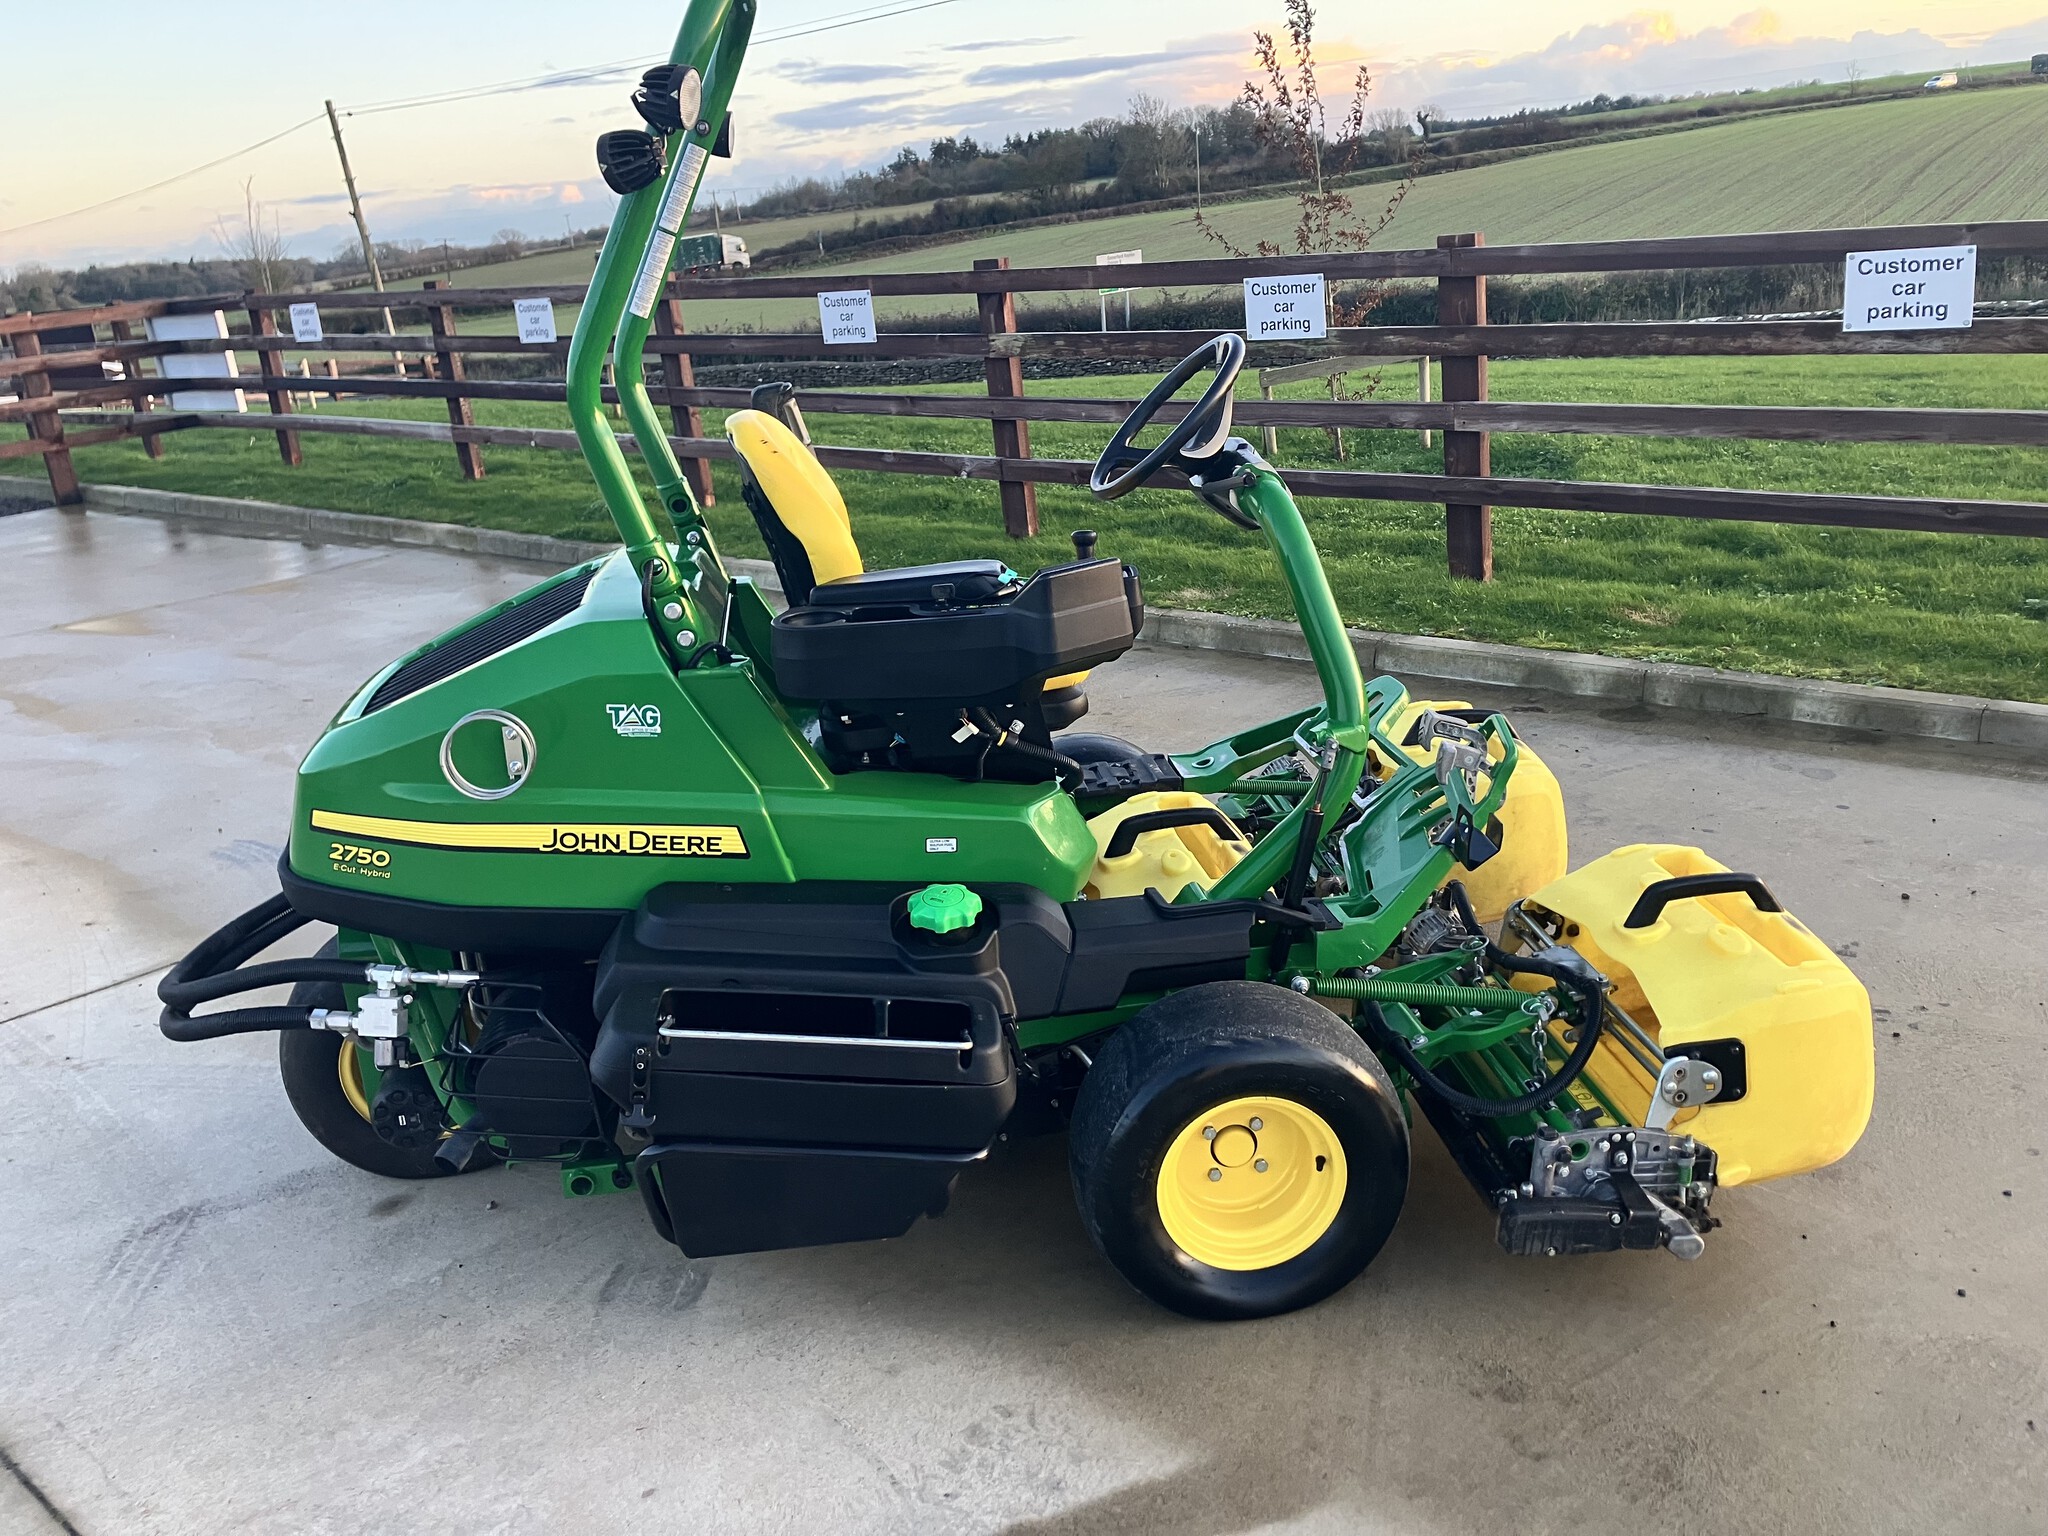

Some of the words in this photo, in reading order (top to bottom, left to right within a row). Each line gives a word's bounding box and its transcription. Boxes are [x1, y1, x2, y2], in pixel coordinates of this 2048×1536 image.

[1858, 257, 1965, 275] Customer
[1251, 282, 1317, 296] Customer
[1892, 282, 1926, 296] car
[517, 303, 549, 314] Customer
[823, 296, 867, 308] Customer
[1274, 302, 1295, 313] car
[839, 312, 854, 322] car
[1866, 301, 1949, 323] parking
[530, 316, 540, 325] car
[1260, 317, 1311, 334] parking
[525, 327, 549, 339] parking
[832, 325, 866, 339] parking
[607, 705, 660, 728] TAG
[542, 828, 621, 850] JOHN
[628, 830, 723, 853] DEERE
[329, 842, 391, 867] 2750
[360, 867, 391, 879] Hybrid
